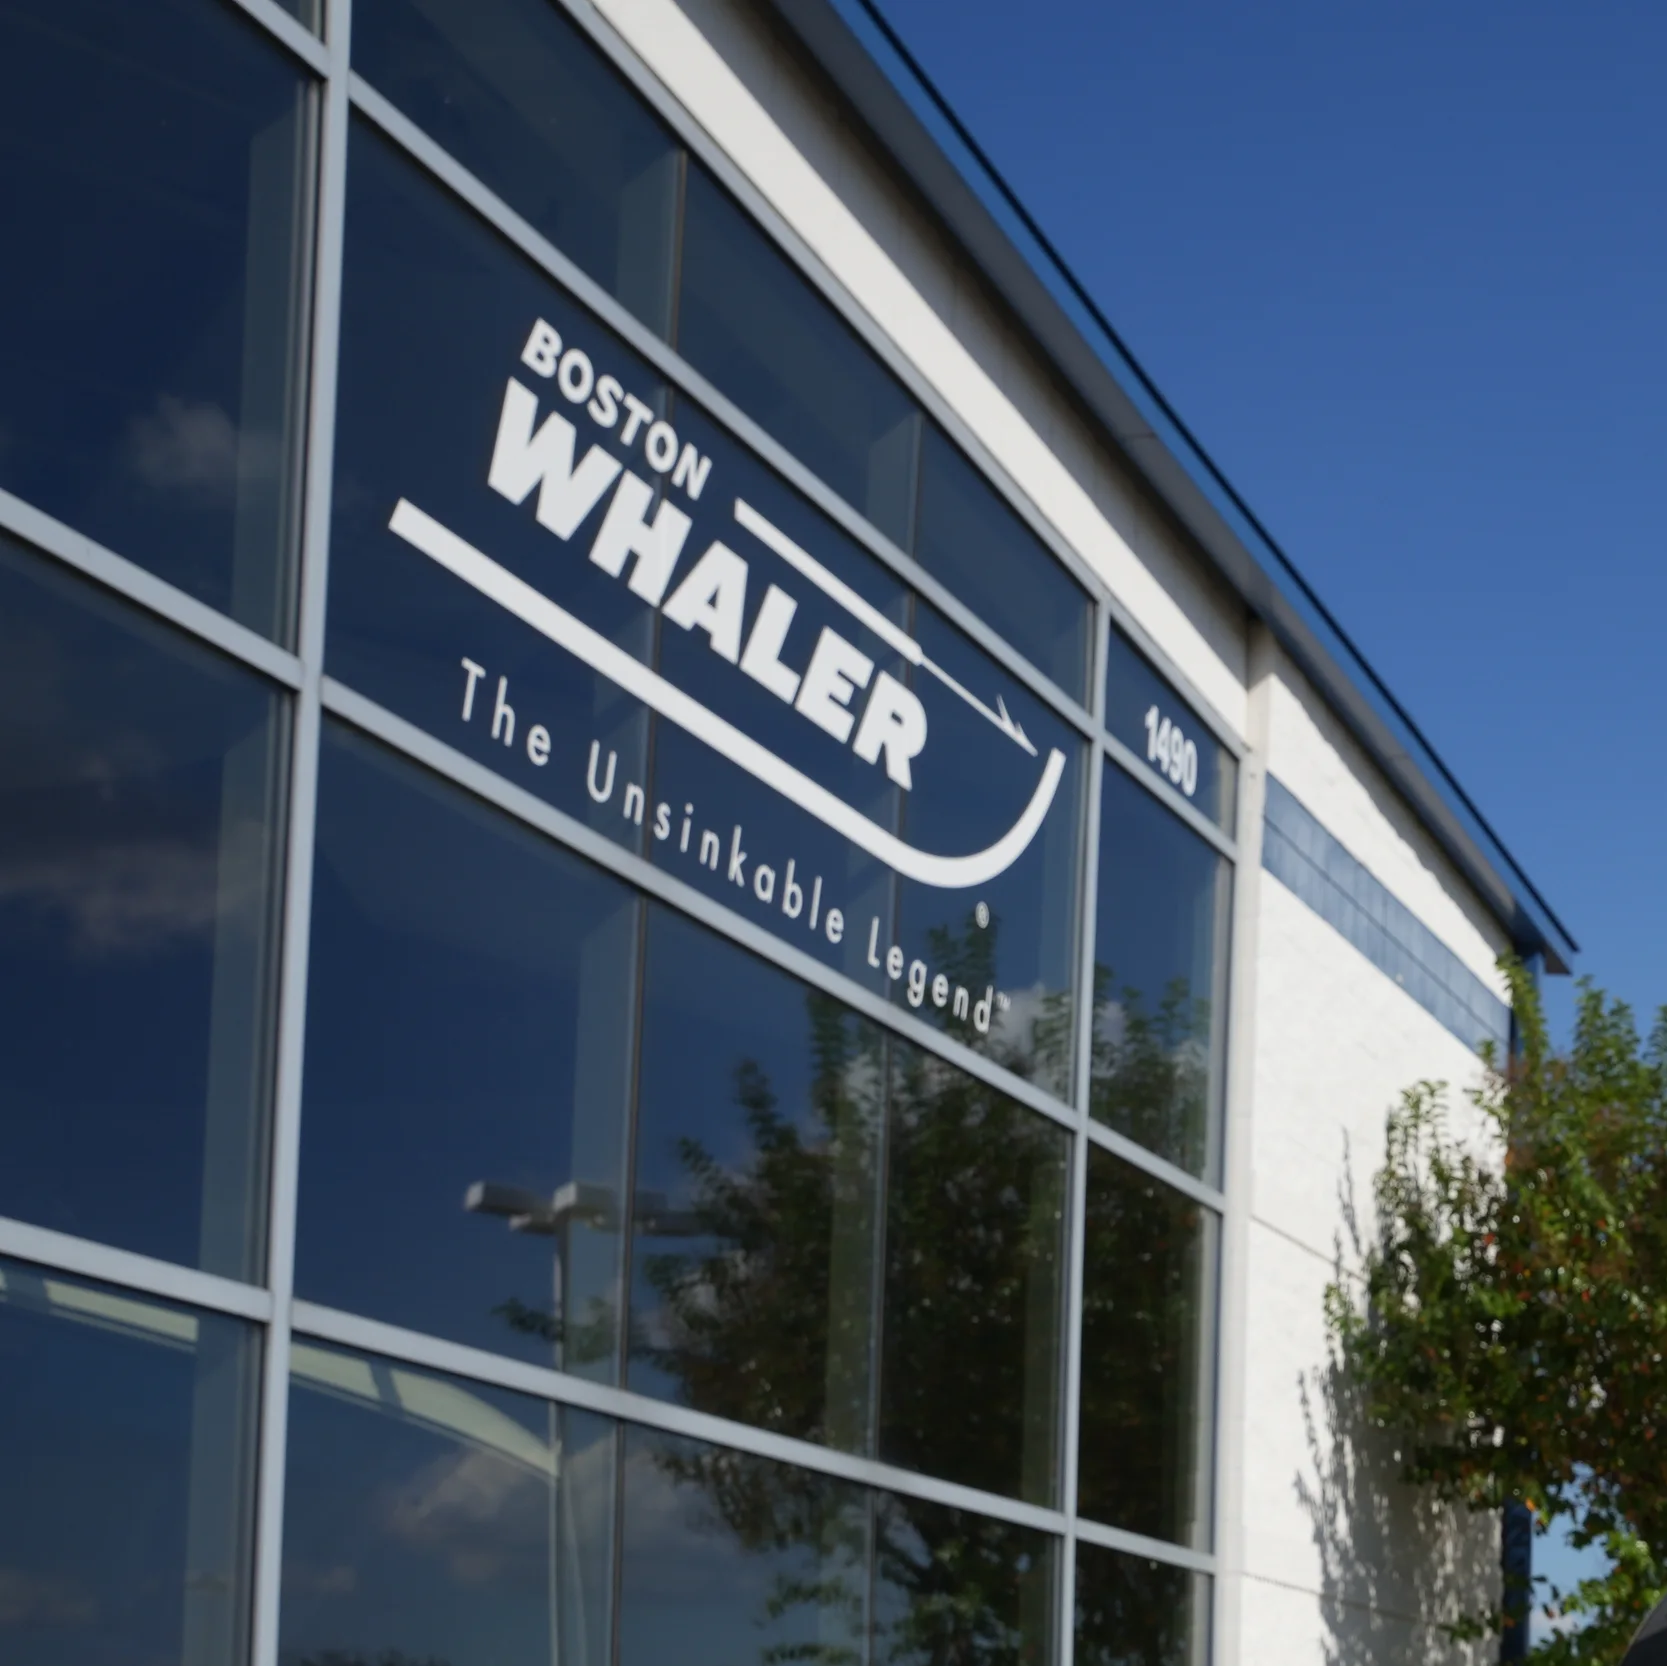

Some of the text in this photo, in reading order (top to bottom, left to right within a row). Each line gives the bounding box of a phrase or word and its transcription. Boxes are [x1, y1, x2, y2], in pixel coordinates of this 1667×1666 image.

[520, 317, 713, 500] BOSTON
[486, 376, 929, 792] WHALER
[460, 657, 552, 767] The
[586, 740, 845, 944] Unsinkable
[1144, 704, 1199, 797] 1490
